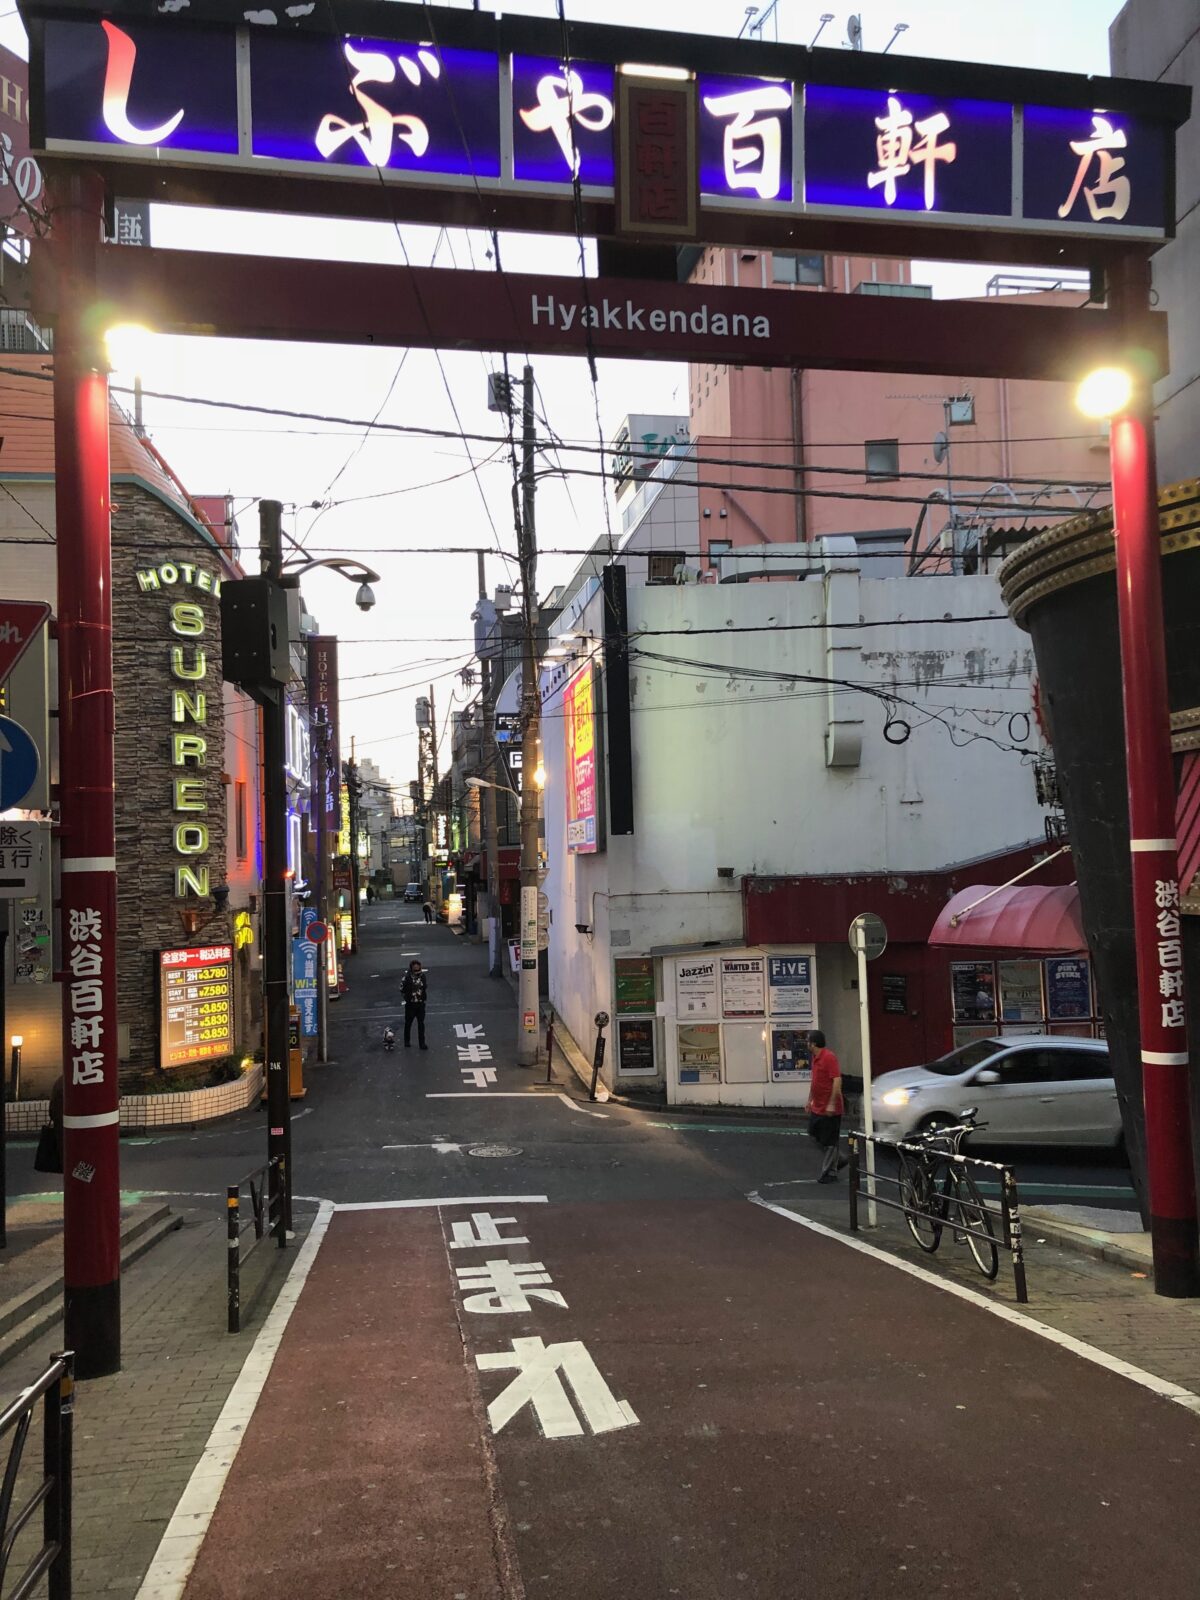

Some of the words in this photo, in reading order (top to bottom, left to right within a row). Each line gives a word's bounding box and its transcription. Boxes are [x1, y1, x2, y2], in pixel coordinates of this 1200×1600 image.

[531, 294, 770, 338] Hyakkendana
[136, 563, 221, 598] HOTEL
[317, 651, 328, 703] HOTEL
[169, 603, 210, 897] SUNREON
[0, 849, 32, 869] 行
[724, 963, 750, 971] WANTED
[1154, 879, 1185, 1028] 渋谷百軒店
[69, 907, 105, 1086] 渋谷百軒店
[295, 978, 318, 989] Wi-F
